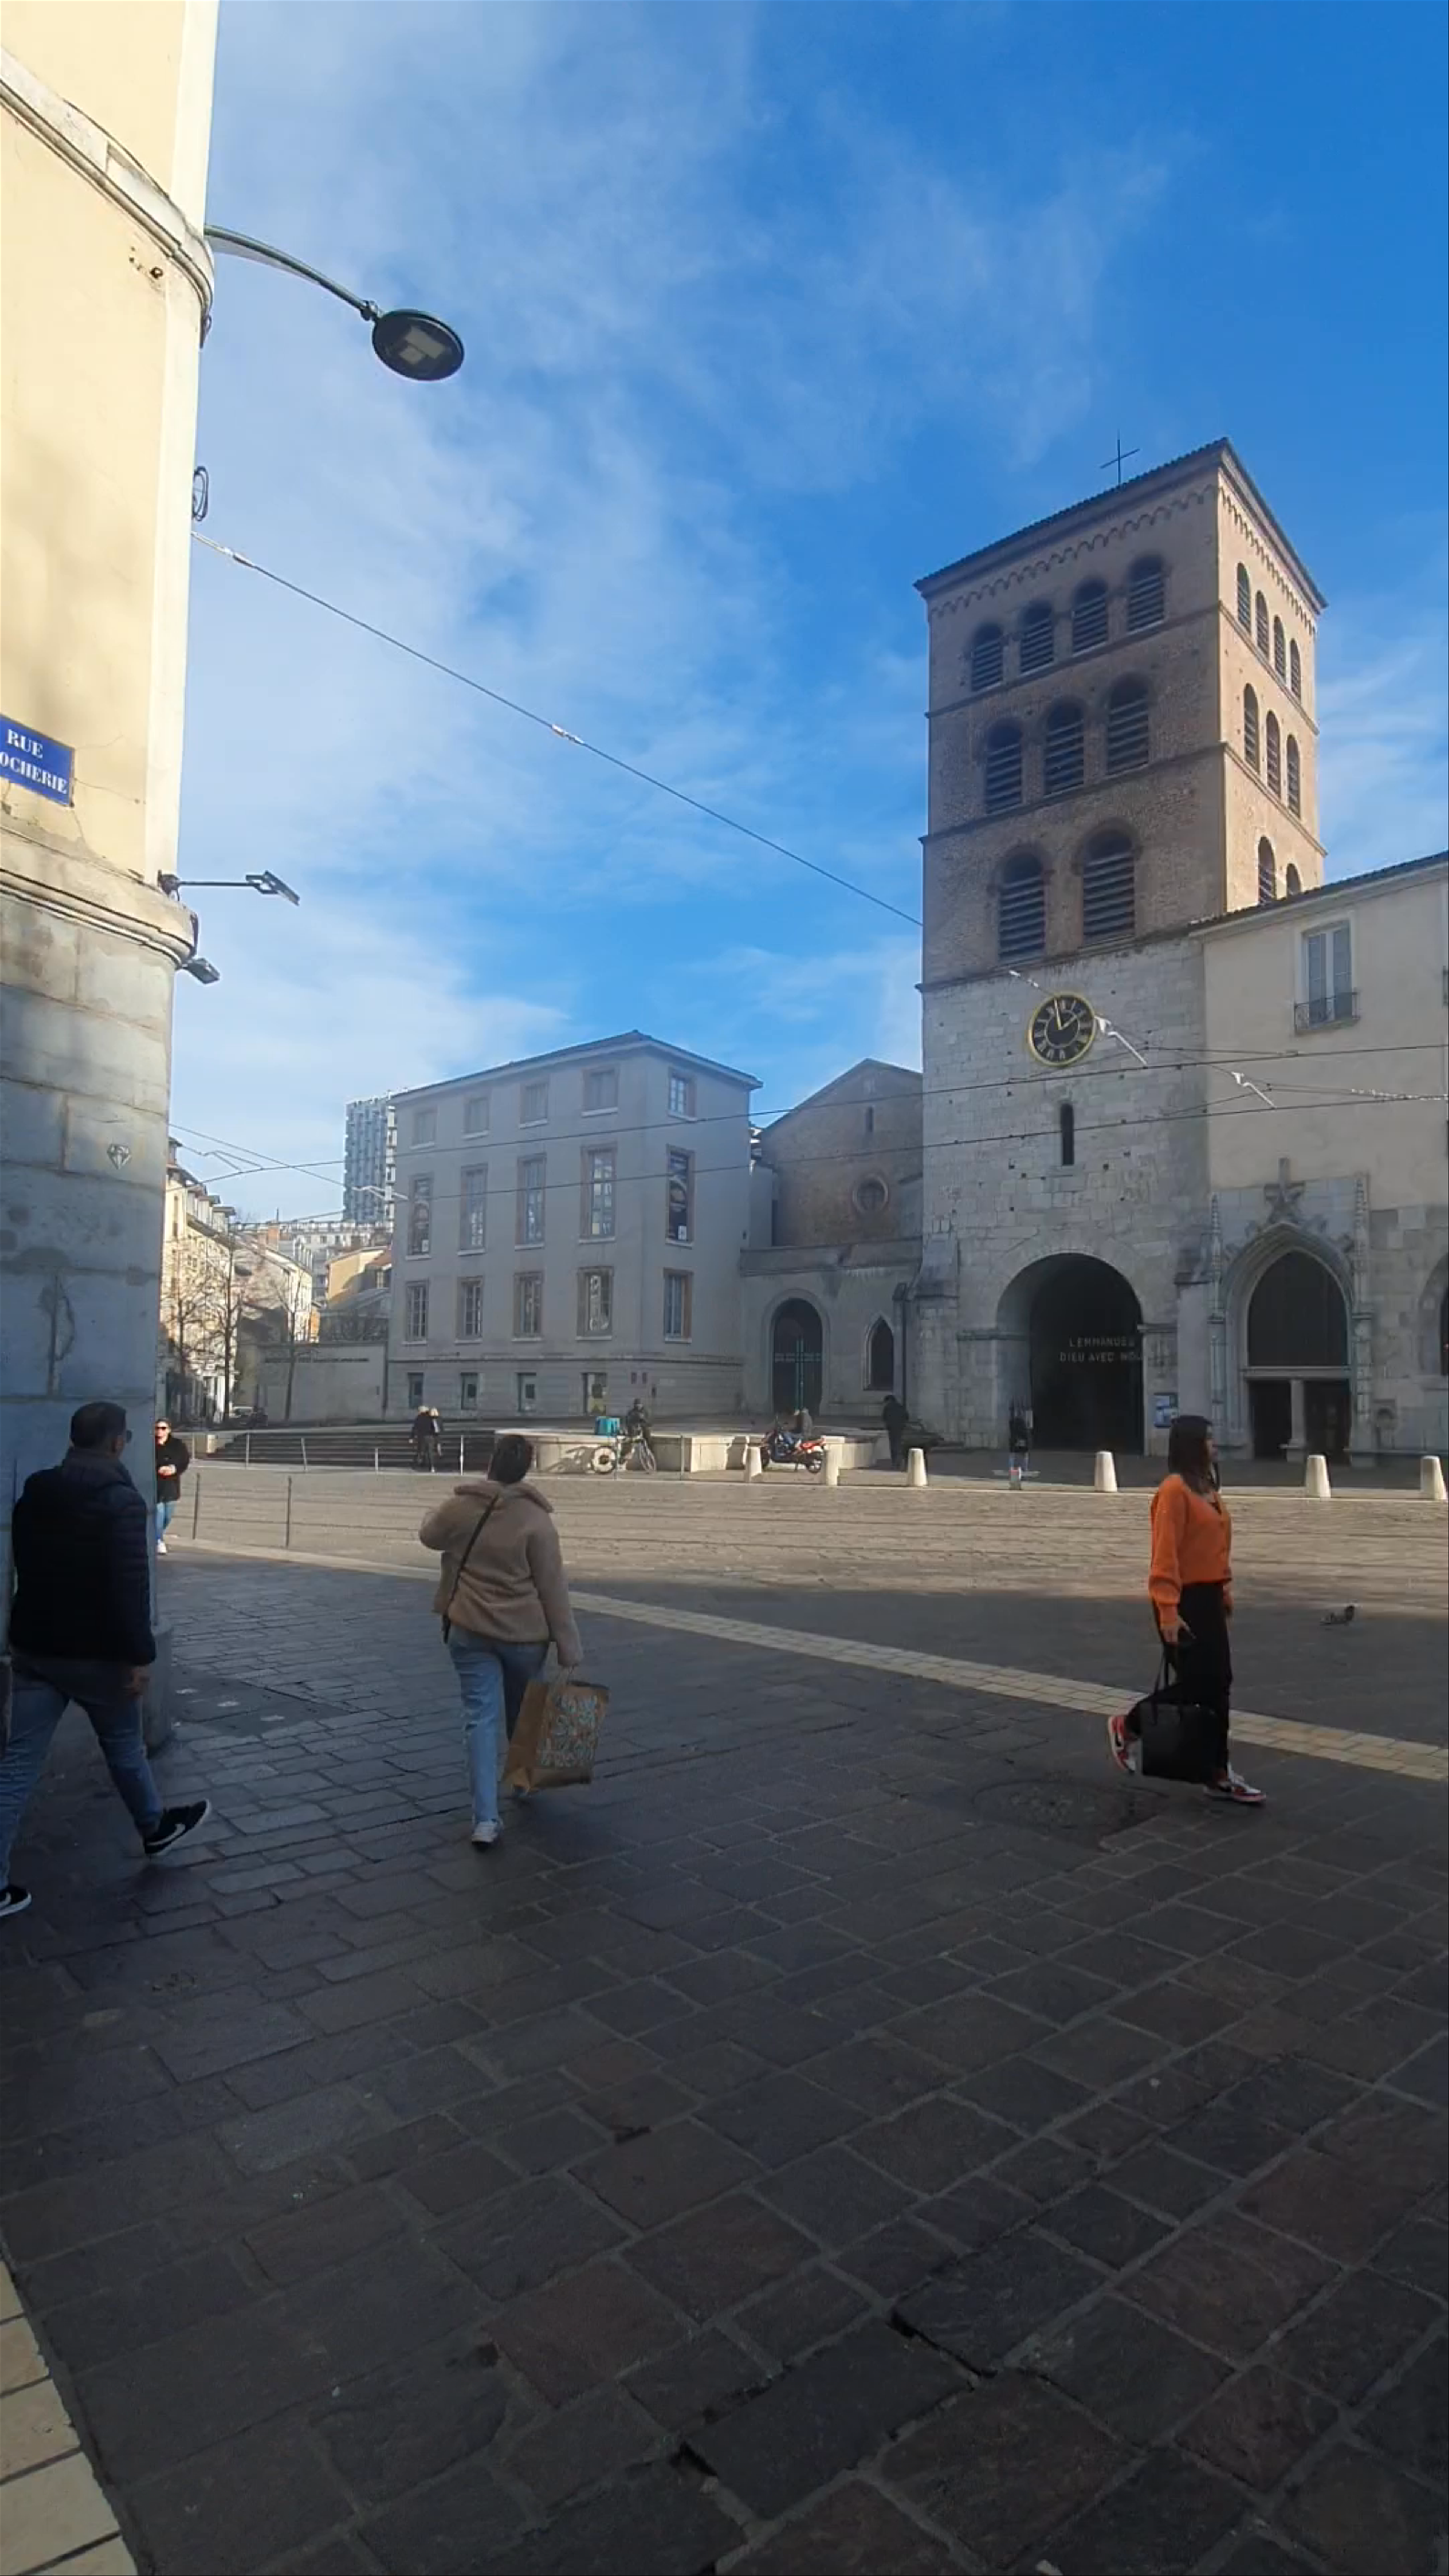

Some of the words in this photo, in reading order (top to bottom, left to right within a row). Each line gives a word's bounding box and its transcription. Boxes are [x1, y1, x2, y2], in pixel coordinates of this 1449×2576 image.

[7, 729, 43, 759] RUE
[1060, 1352, 1084, 1362] DIEU
[1088, 1352, 1114, 1362] AVEC
